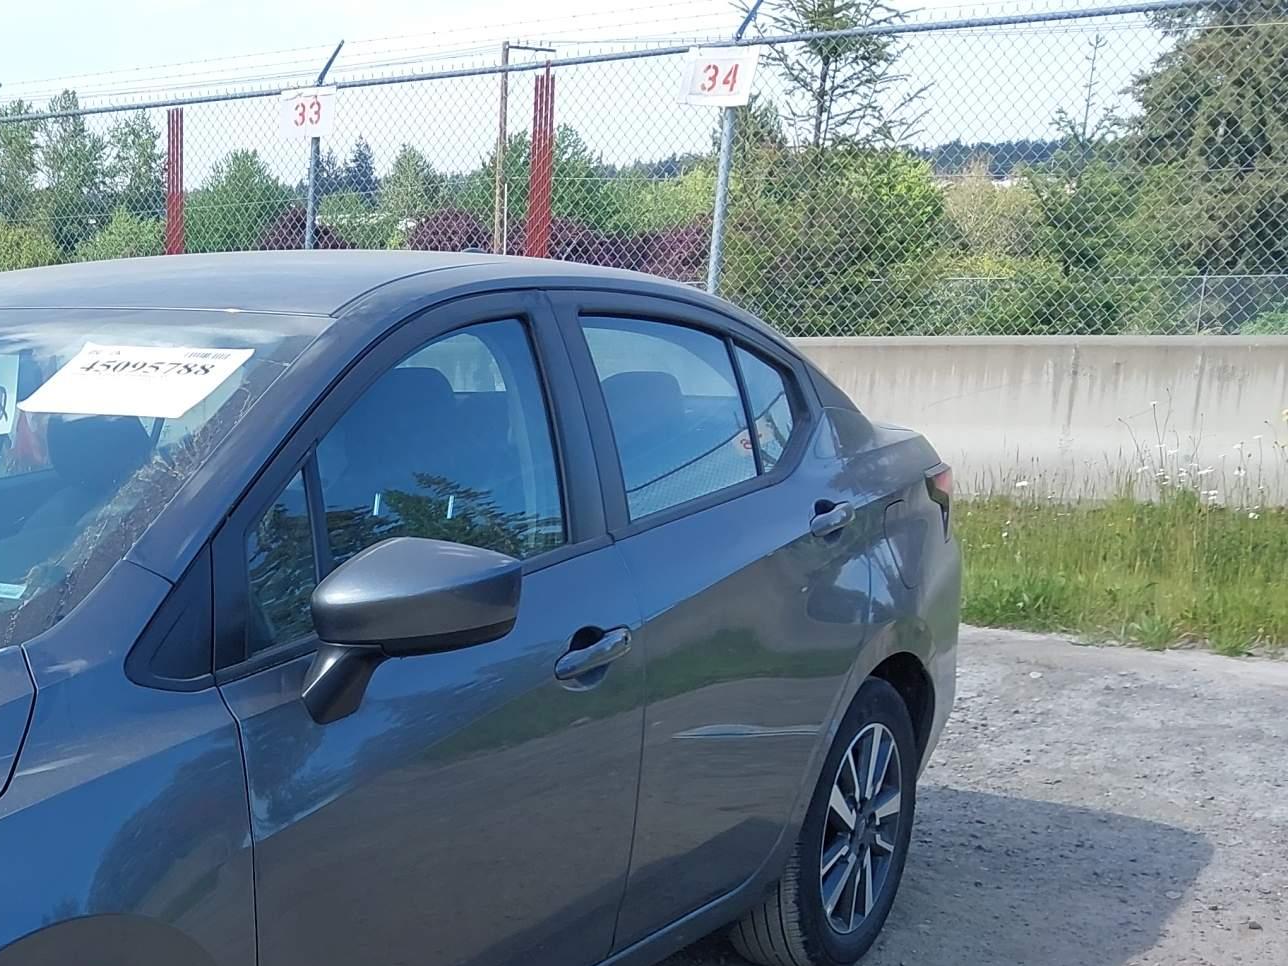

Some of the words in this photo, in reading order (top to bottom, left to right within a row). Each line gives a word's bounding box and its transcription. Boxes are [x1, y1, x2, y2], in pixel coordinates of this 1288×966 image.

[700, 63, 739, 92] 34
[294, 101, 321, 126] 33
[80, 359, 215, 375] 45095788
